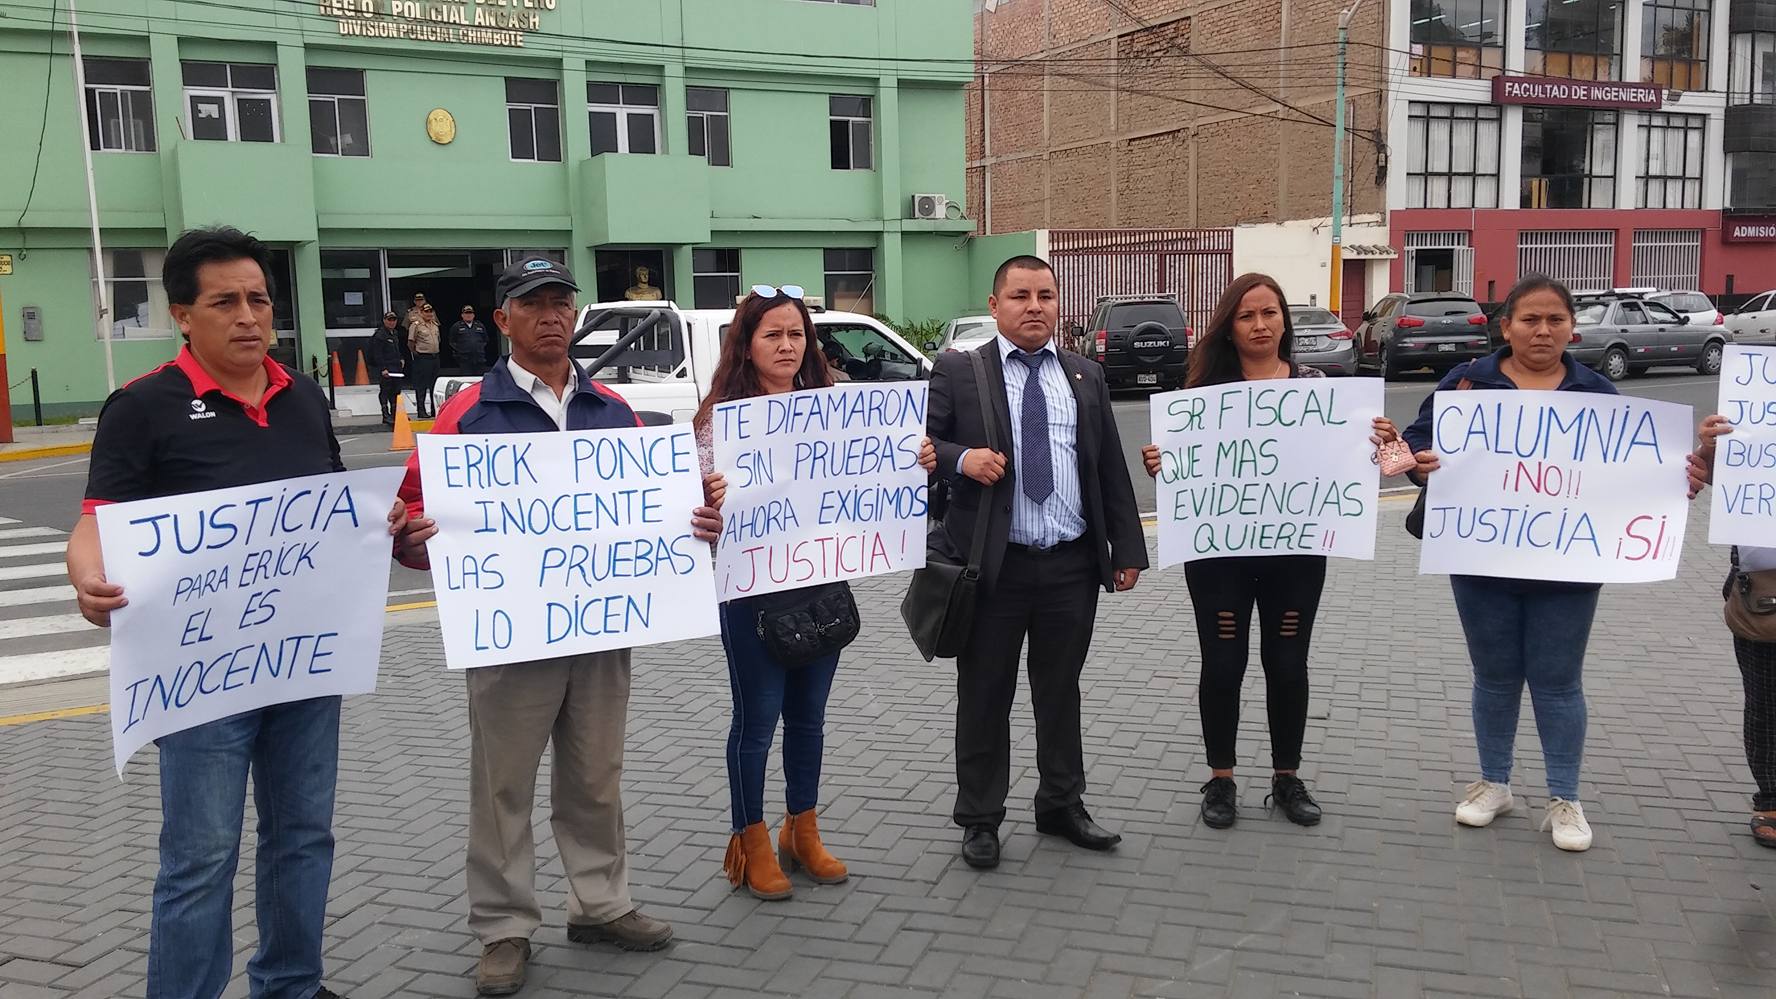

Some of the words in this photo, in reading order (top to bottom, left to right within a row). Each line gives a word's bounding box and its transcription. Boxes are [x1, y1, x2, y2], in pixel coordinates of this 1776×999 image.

[338, 19, 398, 38] DIVISION
[399, 23, 457, 43] POLICIAL
[460, 28, 525, 47] CHIMBOTE
[391, 0, 470, 25] POLICIAL
[474, 6, 540, 30] ANCASH
[1505, 82, 1568, 99] FACULTAD
[1571, 86, 1588, 100] DE
[1590, 87, 1657, 103] INGENIERIA
[1133, 340, 1170, 349] SUZUKI
[188, 411, 217, 420] WALON
[717, 403, 752, 442] TE
[765, 387, 927, 436] DIFAMARON
[1167, 396, 1207, 433] SR
[1218, 387, 1348, 430] FISCAL
[1437, 402, 1663, 465] CALUMNIA
[443, 438, 538, 489] ERICK
[573, 432, 691, 483] PONCE
[736, 447, 774, 488] SIN
[794, 433, 918, 481] PRUEBAS
[1160, 444, 1203, 485] QUE
[1215, 438, 1279, 478] MAS
[129, 482, 359, 558] JUSTICIA
[474, 487, 663, 535] INOCENTE
[722, 497, 800, 550] AHORA
[818, 482, 928, 526] EXIGIMOS
[1173, 476, 1364, 521] EVIDENCIAS
[1429, 504, 1602, 558] JUSTICIA
[173, 564, 228, 606] PARA
[238, 540, 320, 588] ERICK
[446, 553, 504, 590] LAS
[539, 534, 695, 588] PRUEBAS
[180, 607, 213, 647] EL
[238, 588, 281, 629] ES
[475, 609, 513, 651] LO
[546, 592, 652, 645] DICEN
[123, 632, 339, 734] INOCENTE
